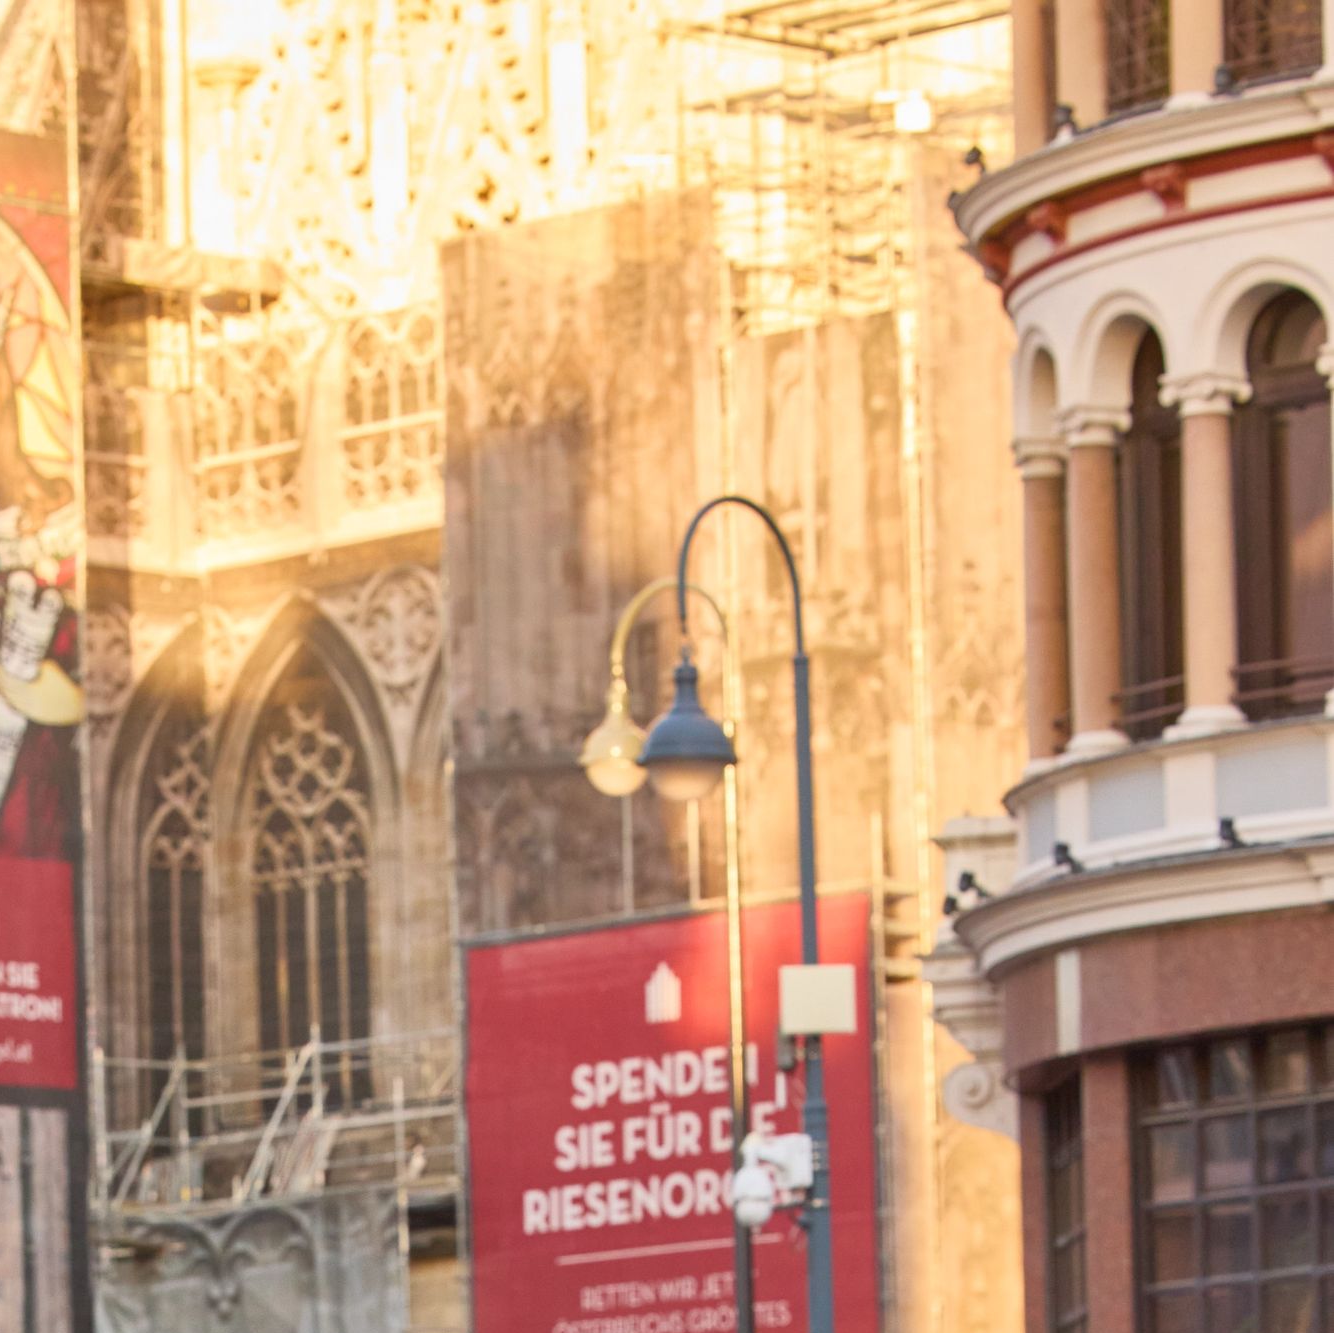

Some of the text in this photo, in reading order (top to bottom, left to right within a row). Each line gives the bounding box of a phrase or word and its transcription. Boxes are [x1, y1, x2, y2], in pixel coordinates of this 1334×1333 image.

[6, 960, 40, 990] SIE
[553, 1101, 778, 1172] SIE FÜR DE
[659, 1275, 699, 1301] WIR
